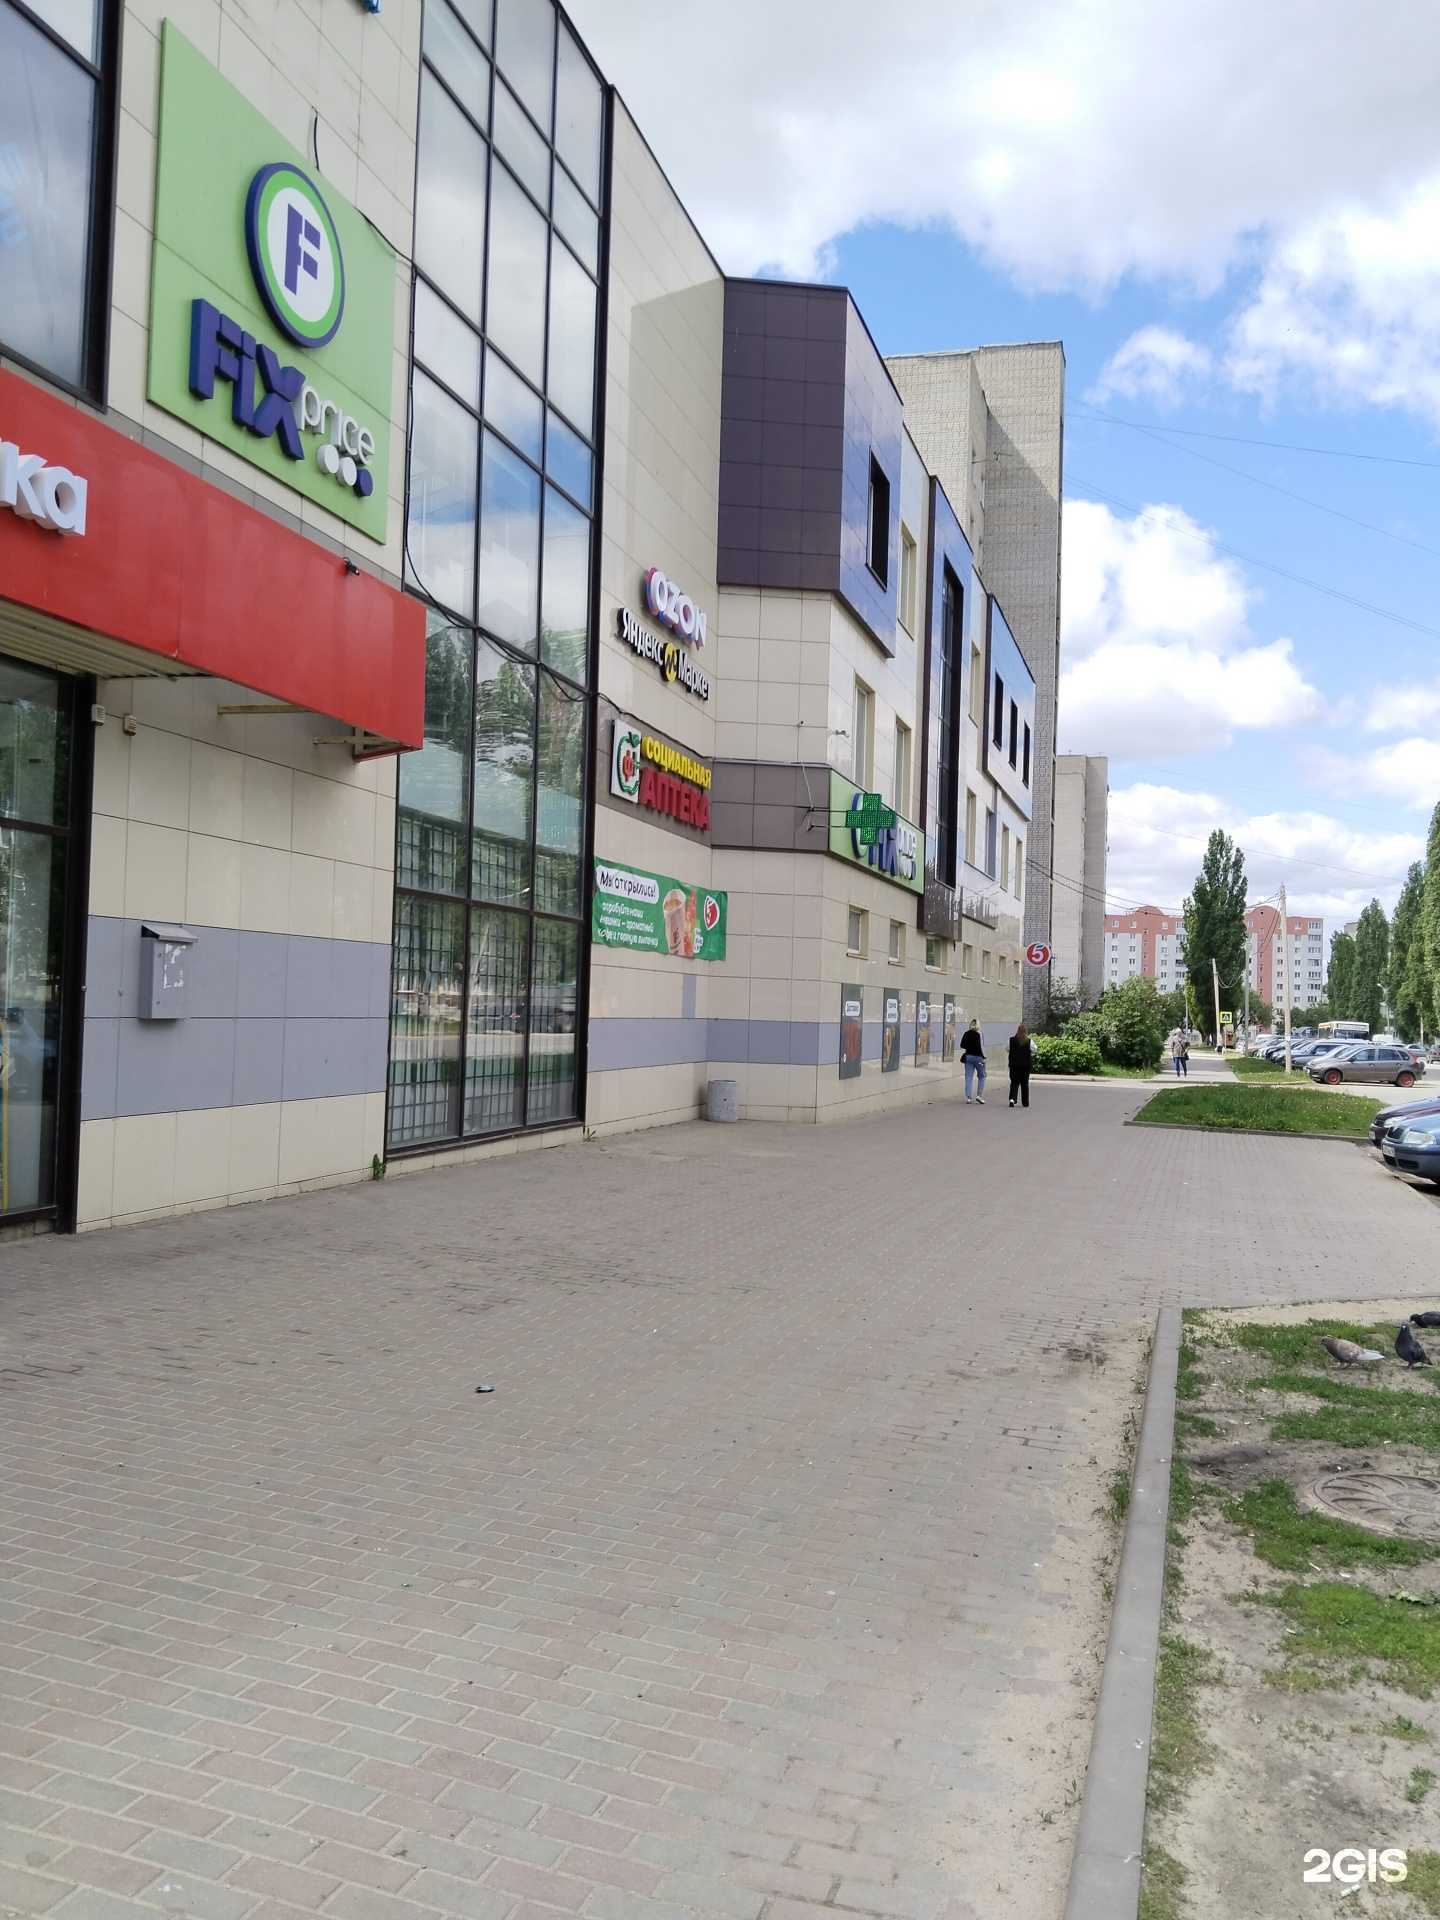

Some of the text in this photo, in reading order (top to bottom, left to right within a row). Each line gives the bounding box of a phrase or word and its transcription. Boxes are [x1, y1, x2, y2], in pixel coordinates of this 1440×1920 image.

[300, 384, 375, 466] price
[619, 607, 664, 667] Яндекс
[645, 568, 707, 647] OZON
[642, 736, 712, 791] СОЦИАЛЬНАЯ
[640, 767, 712, 832] АПТЕКА
